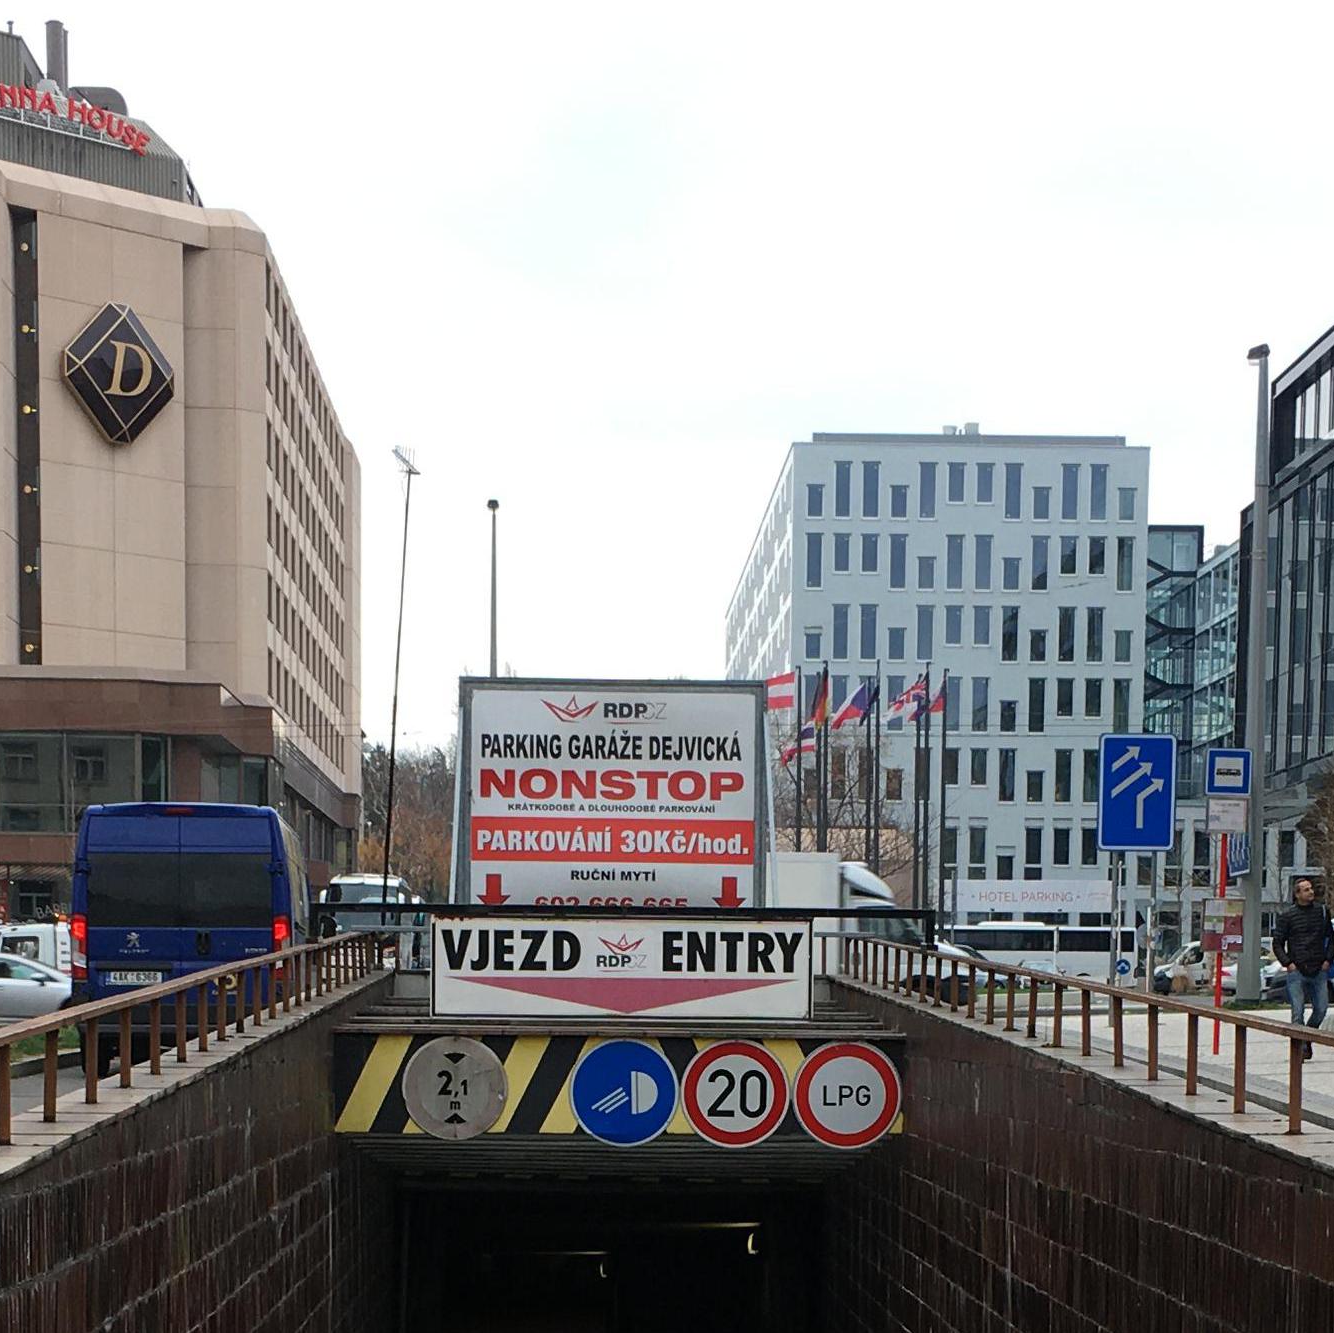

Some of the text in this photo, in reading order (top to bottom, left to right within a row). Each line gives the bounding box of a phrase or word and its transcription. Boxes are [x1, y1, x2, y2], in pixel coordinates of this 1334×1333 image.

[67, 96, 151, 157] HOUSE
[104, 339, 153, 397] D
[481, 729, 742, 762] PARKING GARÁŽE DEJVICKÁ
[479, 768, 744, 801] NONSTOP
[507, 802, 716, 814] KRÁTKODOBÉ A DLOUHODOBÉ PARKOVÁNÍ
[476, 825, 750, 855] PARKOVÁNÍ 30Kč/hod.
[570, 868, 656, 882] RUČNÍ MYTÍ
[979, 891, 1074, 903] HOTEL PARKING
[441, 929, 582, 972] VJEZD
[661, 930, 804, 974] ENTRY
[436, 1070, 468, 1098] 2,1
[707, 1068, 767, 1119] 20
[823, 1083, 872, 1108] LPG
[450, 1101, 462, 1111] m
